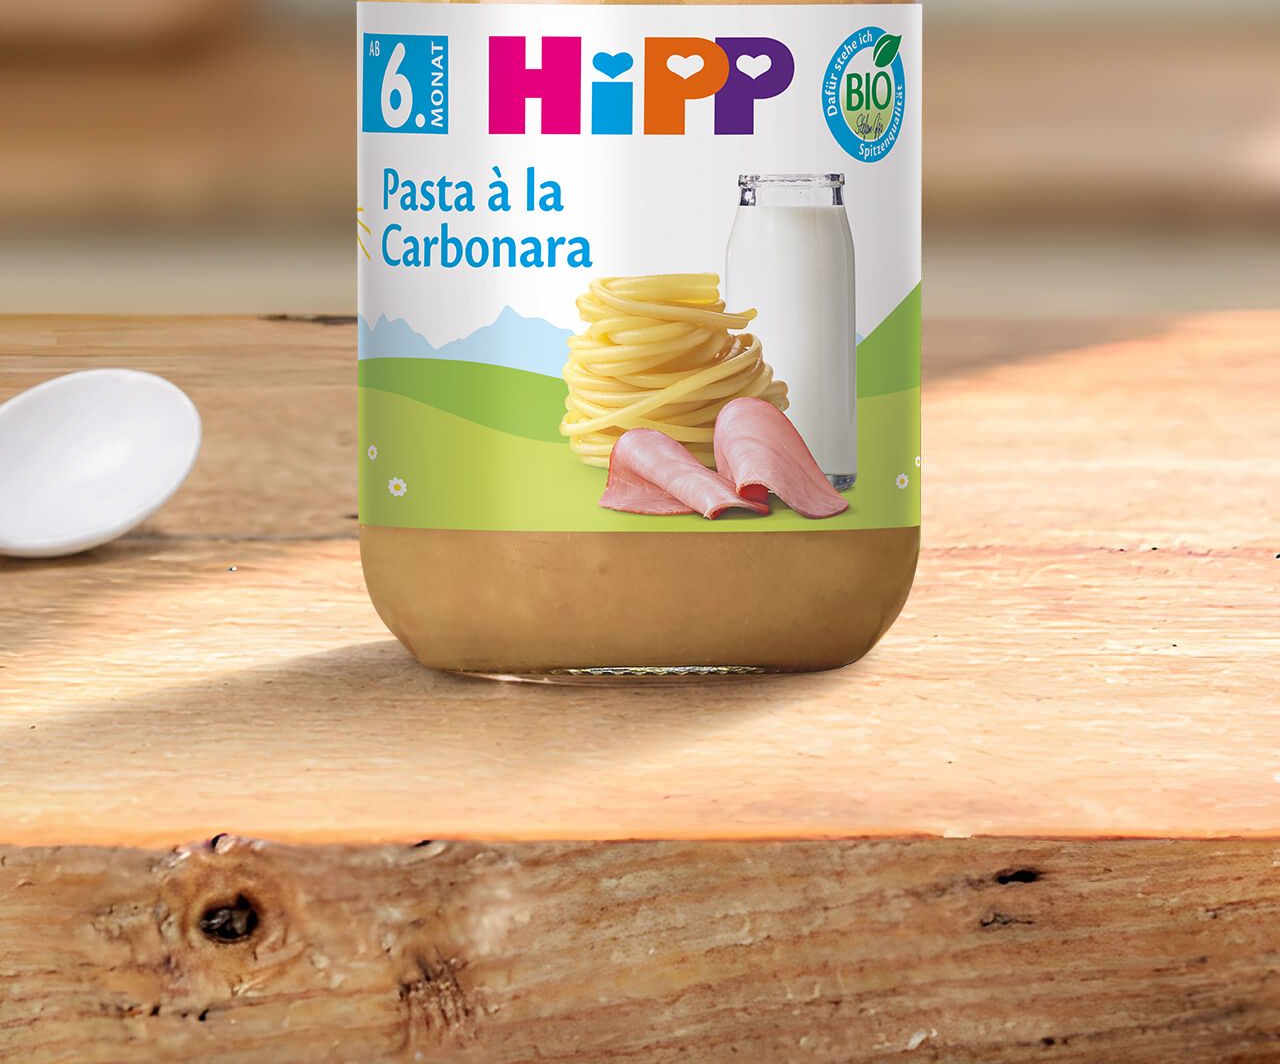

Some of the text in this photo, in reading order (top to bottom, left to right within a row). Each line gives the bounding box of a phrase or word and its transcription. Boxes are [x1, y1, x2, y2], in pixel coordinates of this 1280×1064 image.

[369, 40, 380, 57] AB
[824, 30, 873, 117] Dafür stehe ich
[381, 42, 426, 129] 6.
[431, 41, 444, 128] MONAT
[846, 70, 892, 111] BIO
[858, 83, 903, 160] Spitzenqualität
[383, 165, 564, 212] Pasta à la
[381, 222, 593, 269] Carbonara
